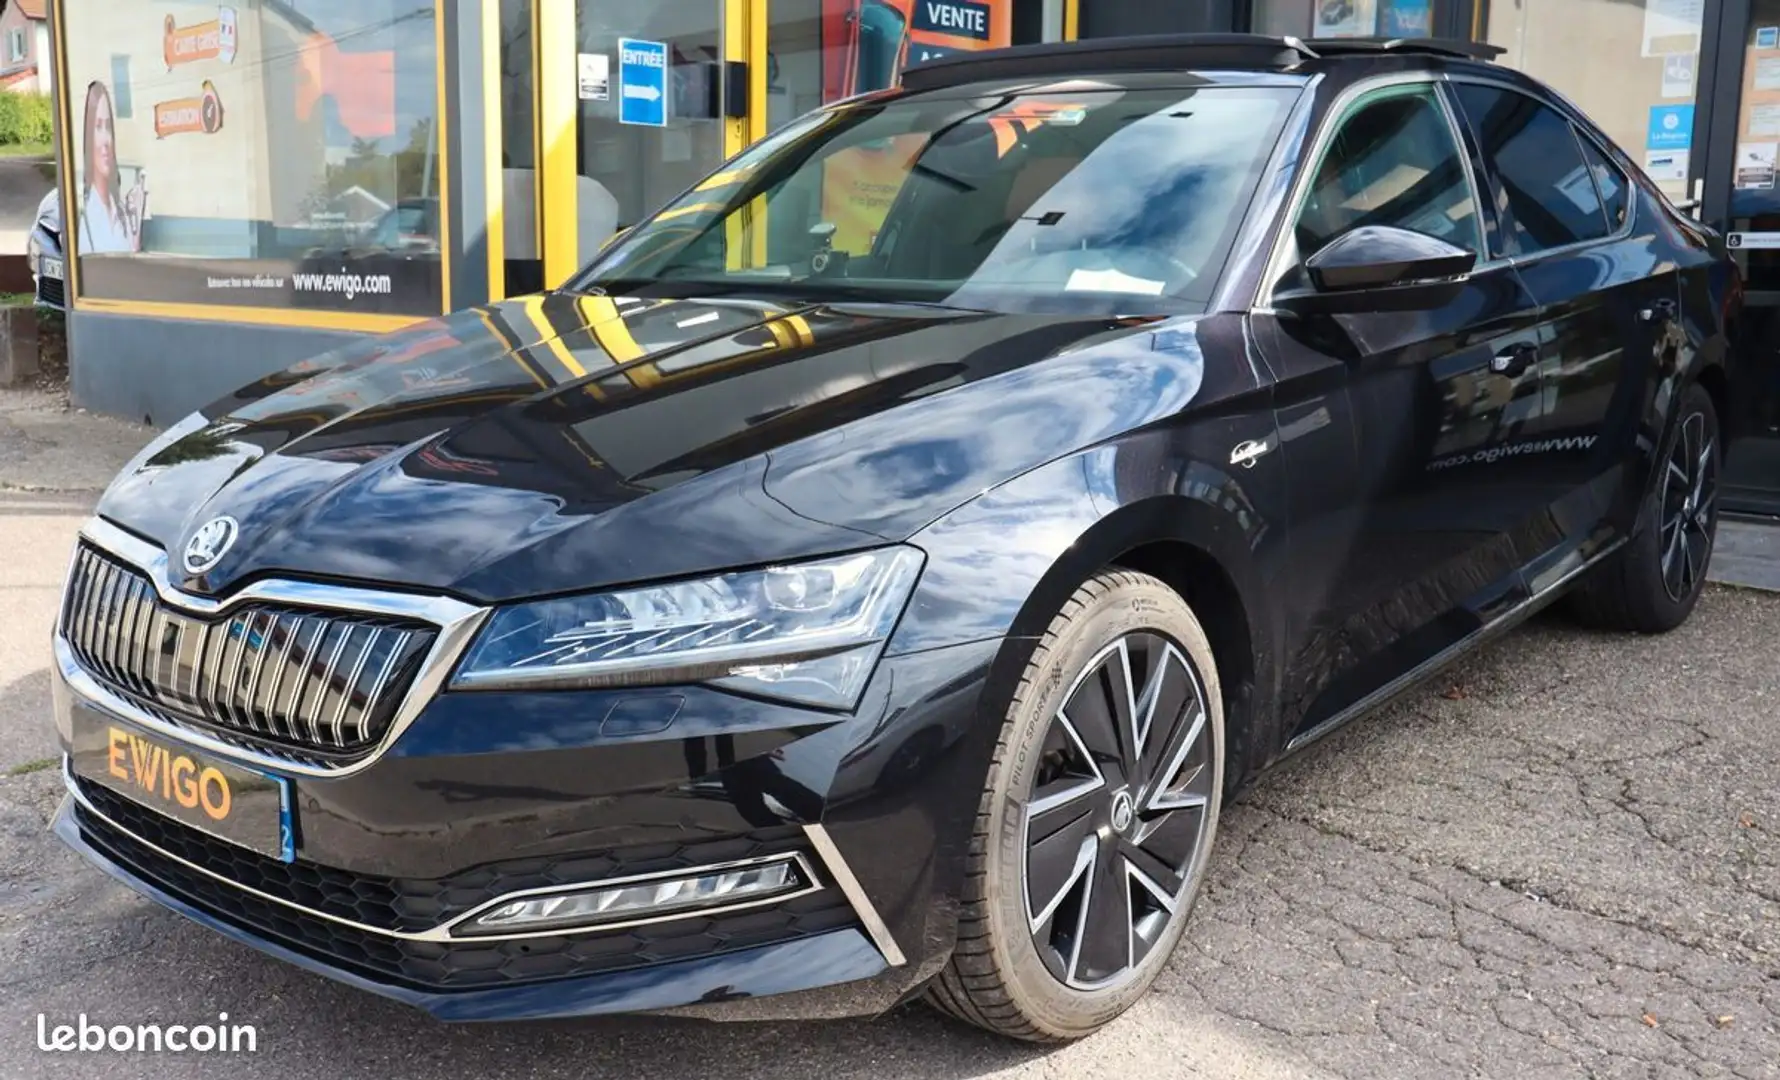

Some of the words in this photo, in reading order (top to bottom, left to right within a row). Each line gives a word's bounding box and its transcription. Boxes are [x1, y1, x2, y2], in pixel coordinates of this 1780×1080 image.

[927, 2, 985, 32] VENTE
[623, 48, 664, 68] ENTRÉE
[292, 266, 391, 299] www.ewigo.com
[108, 726, 232, 821] EWIGO
